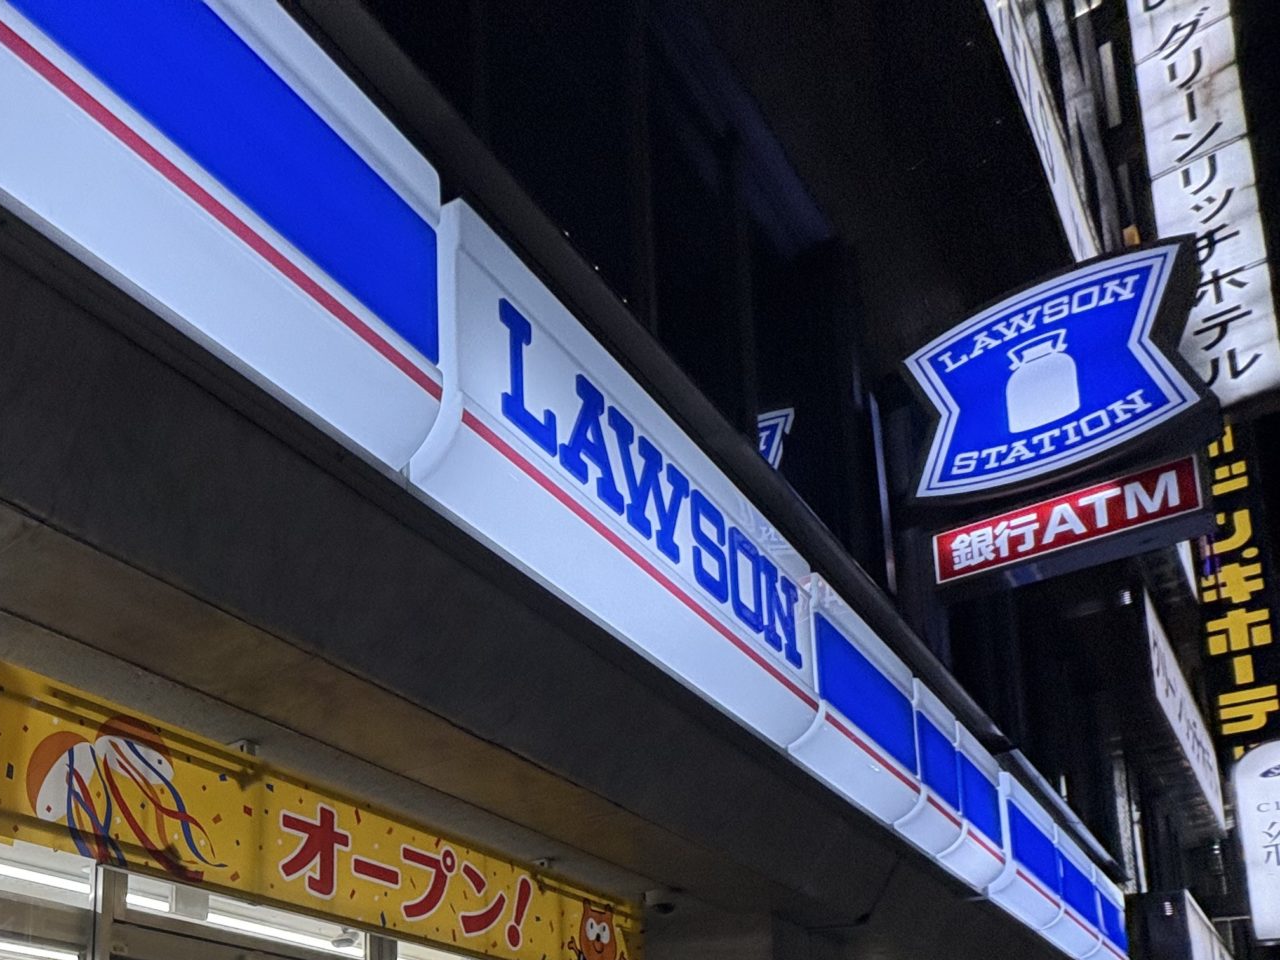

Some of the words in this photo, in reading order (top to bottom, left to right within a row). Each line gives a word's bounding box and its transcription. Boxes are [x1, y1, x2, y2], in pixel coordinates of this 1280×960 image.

[938, 274, 1140, 374] LAWSON
[498, 297, 803, 669] LAWSON
[950, 389, 1153, 476] STATION
[949, 469, 1182, 572] 銀行ATM
